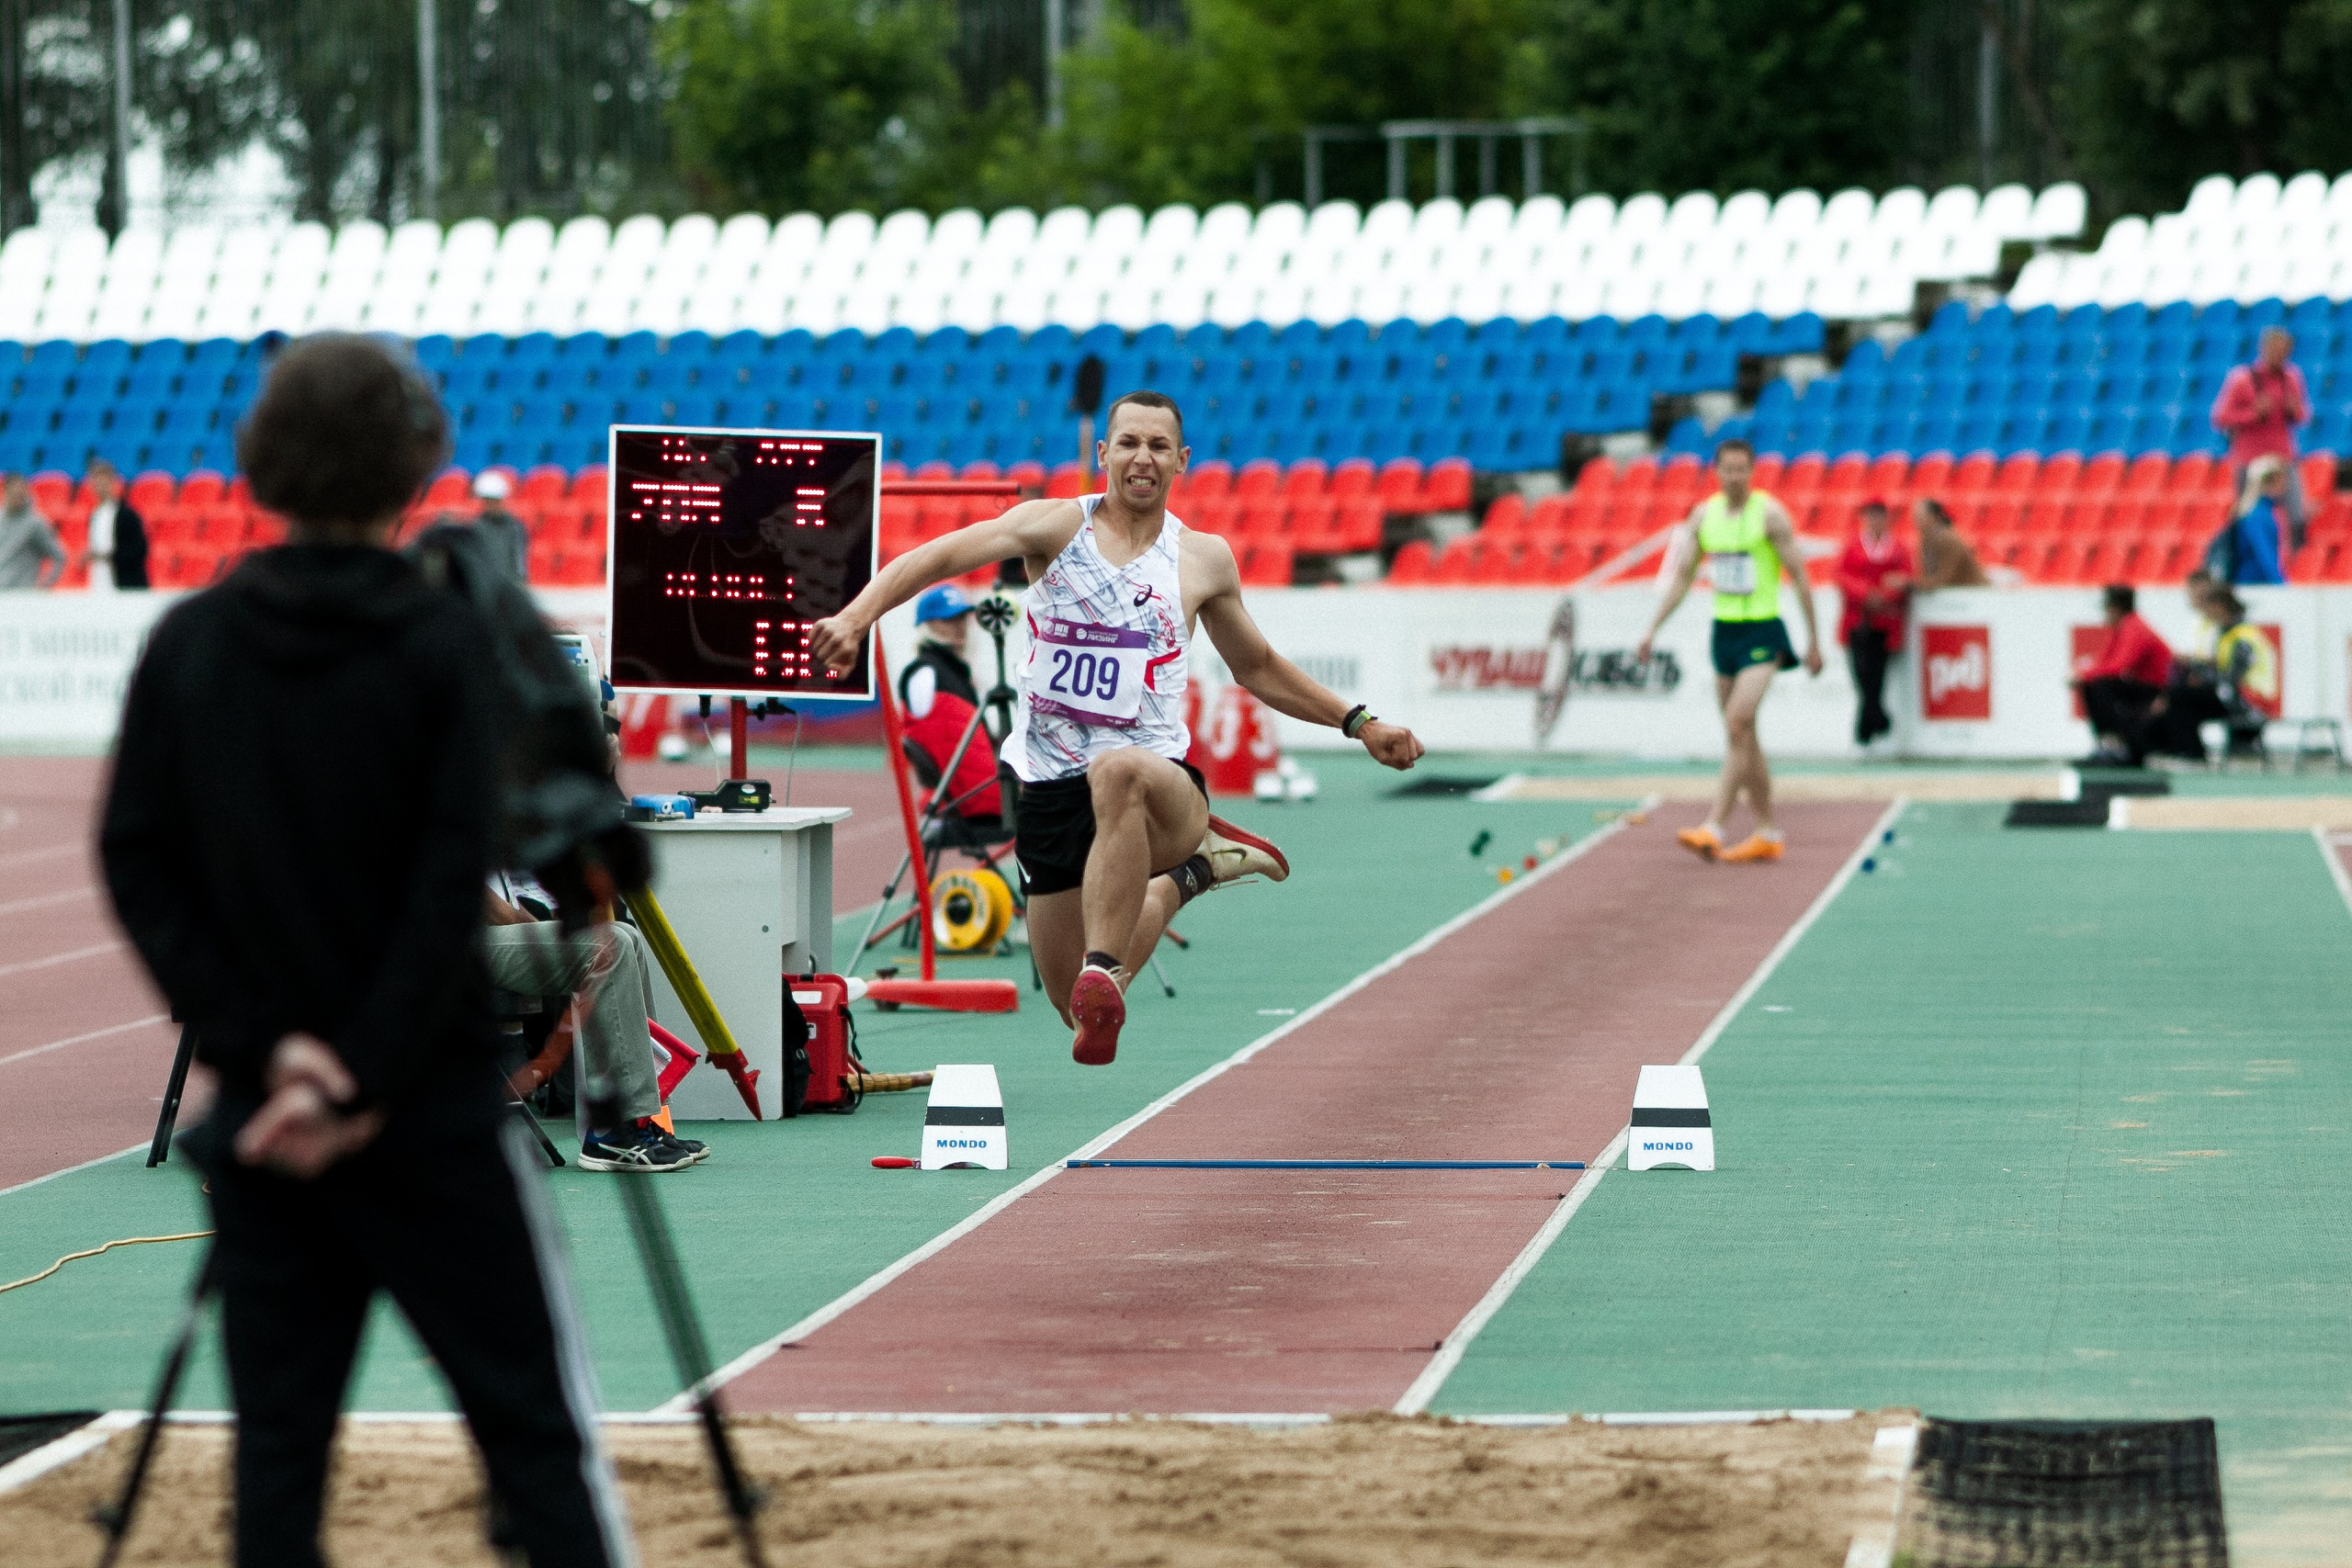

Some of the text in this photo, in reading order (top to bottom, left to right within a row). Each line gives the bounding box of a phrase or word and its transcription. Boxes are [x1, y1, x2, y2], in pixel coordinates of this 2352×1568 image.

[1049, 649, 1120, 701] 209
[936, 1139, 988, 1148] MONDO
[1643, 1142, 1693, 1151] MONDO
